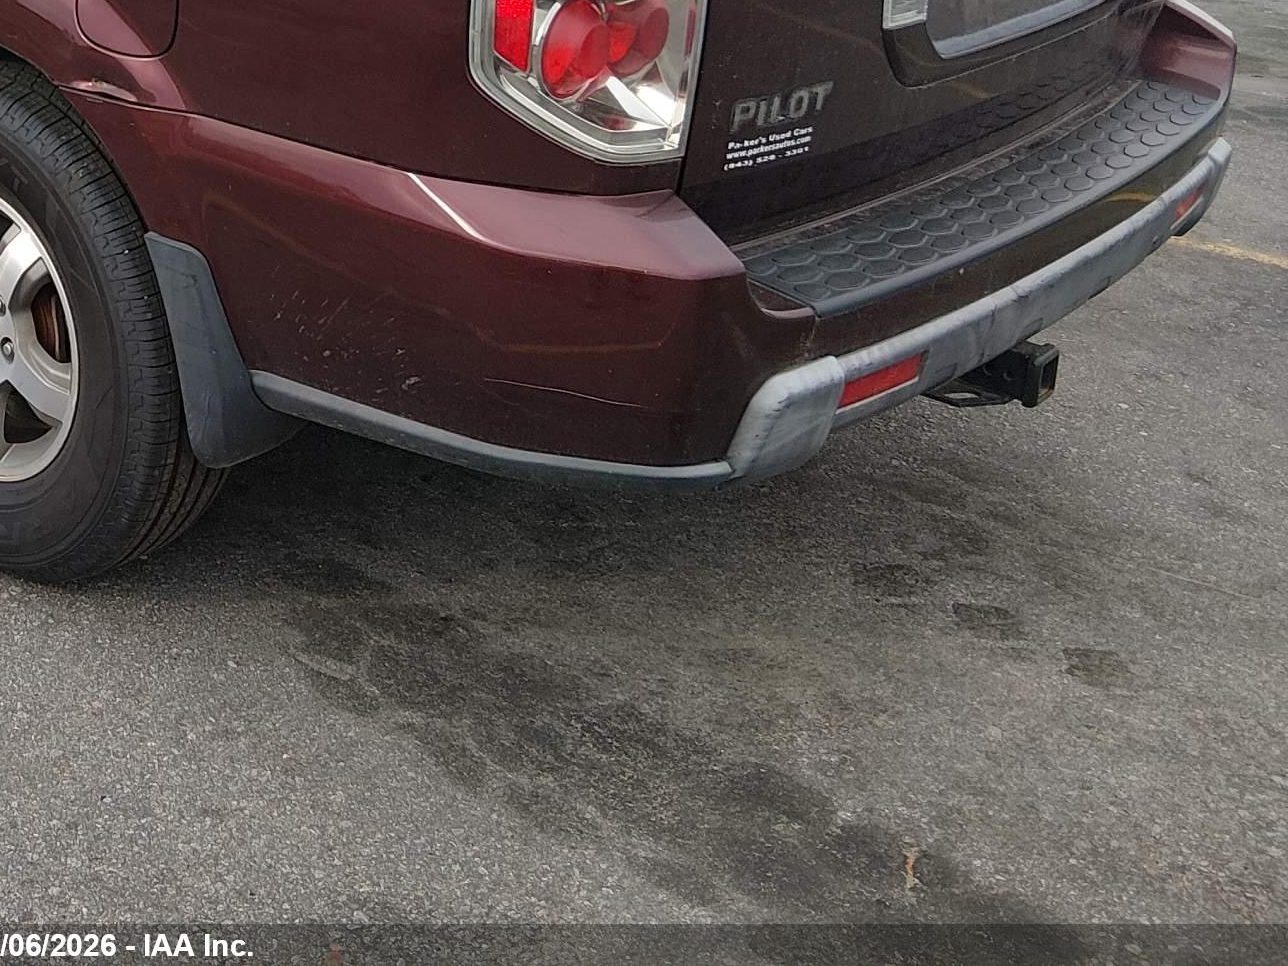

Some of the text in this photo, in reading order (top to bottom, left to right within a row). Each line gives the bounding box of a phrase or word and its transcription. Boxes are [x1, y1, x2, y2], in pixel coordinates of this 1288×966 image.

[731, 81, 833, 132] PILOT
[769, 130, 792, 141] Used
[793, 126, 813, 136] Cars
